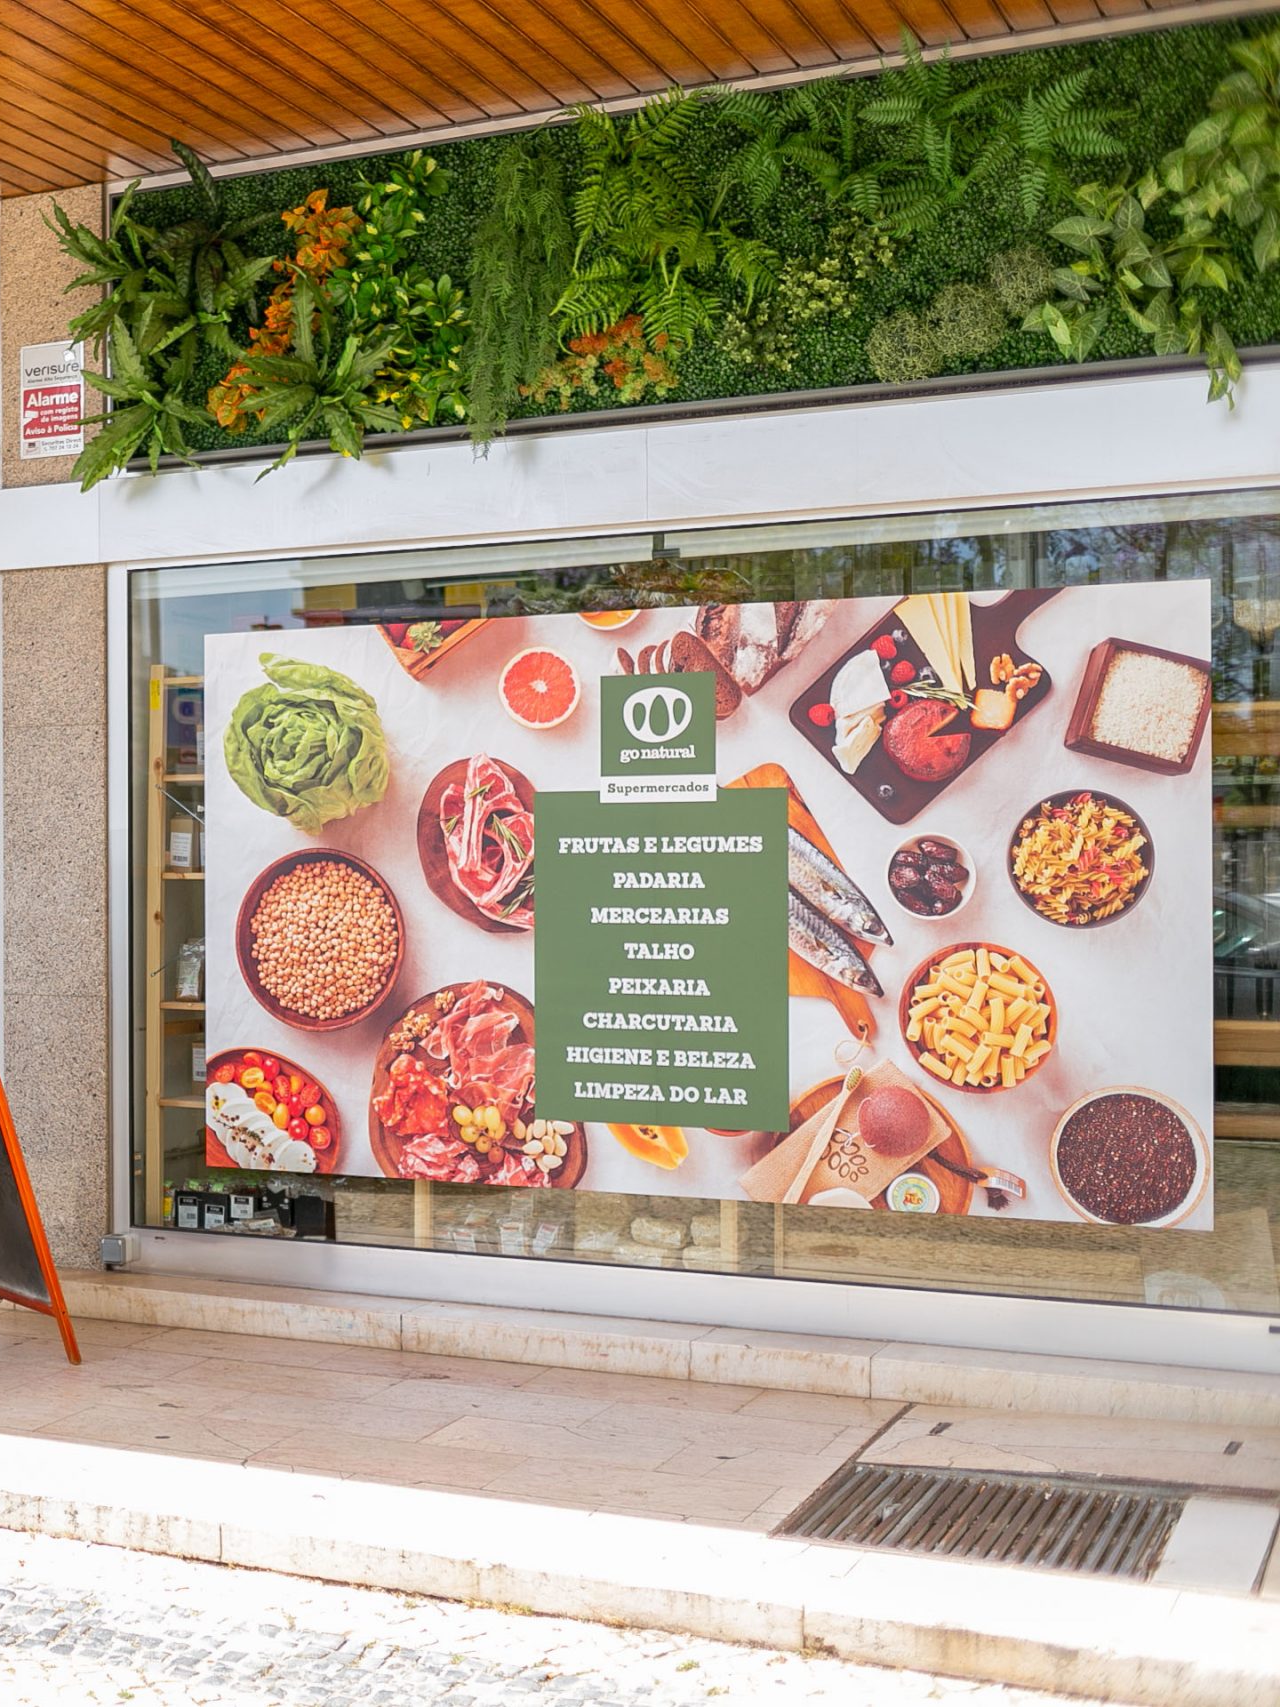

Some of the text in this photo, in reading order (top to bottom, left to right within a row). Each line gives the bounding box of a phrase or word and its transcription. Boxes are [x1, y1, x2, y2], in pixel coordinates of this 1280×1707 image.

[25, 362, 79, 377] verisure
[27, 391, 79, 408] Alarme
[40, 409, 54, 417] com
[50, 413, 78, 423] imagens
[25, 427, 46, 436] Aviso
[619, 745, 696, 764] go natural
[607, 781, 709, 796] Supermercados
[558, 836, 763, 854] FRUTAS E LEGUMES
[613, 872, 706, 889] PADARIA
[590, 907, 730, 925] MERCEARIAS
[624, 942, 695, 960] TALHO
[608, 977, 711, 996] PEIXARIA
[583, 1012, 738, 1033] CHARCUTARIA
[566, 1046, 756, 1070] HIGIENE E BELEZA
[574, 1081, 748, 1106] LIMPEZA DO LAR
